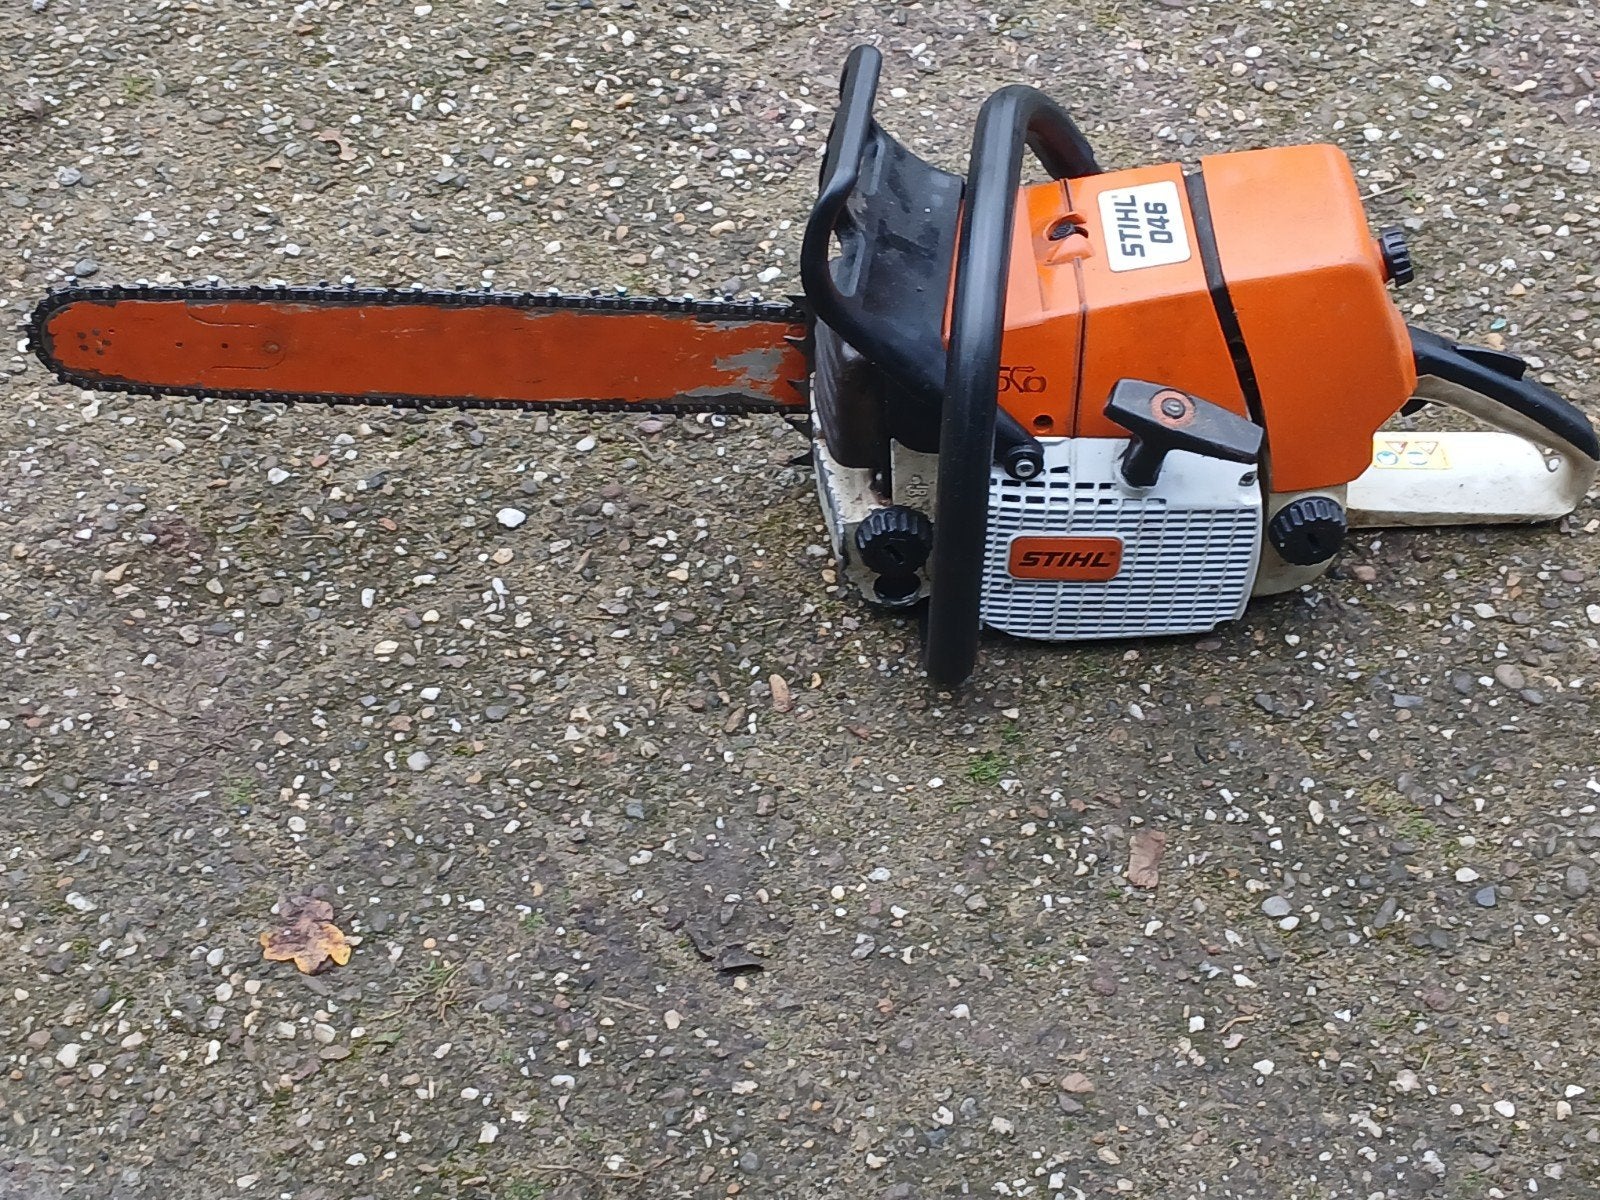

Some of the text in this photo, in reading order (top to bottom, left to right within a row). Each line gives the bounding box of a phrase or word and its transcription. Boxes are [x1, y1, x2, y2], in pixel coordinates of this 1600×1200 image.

[1114, 194, 1146, 257] STIHL
[1144, 202, 1173, 244] 046
[1018, 551, 1111, 568] STIHL
